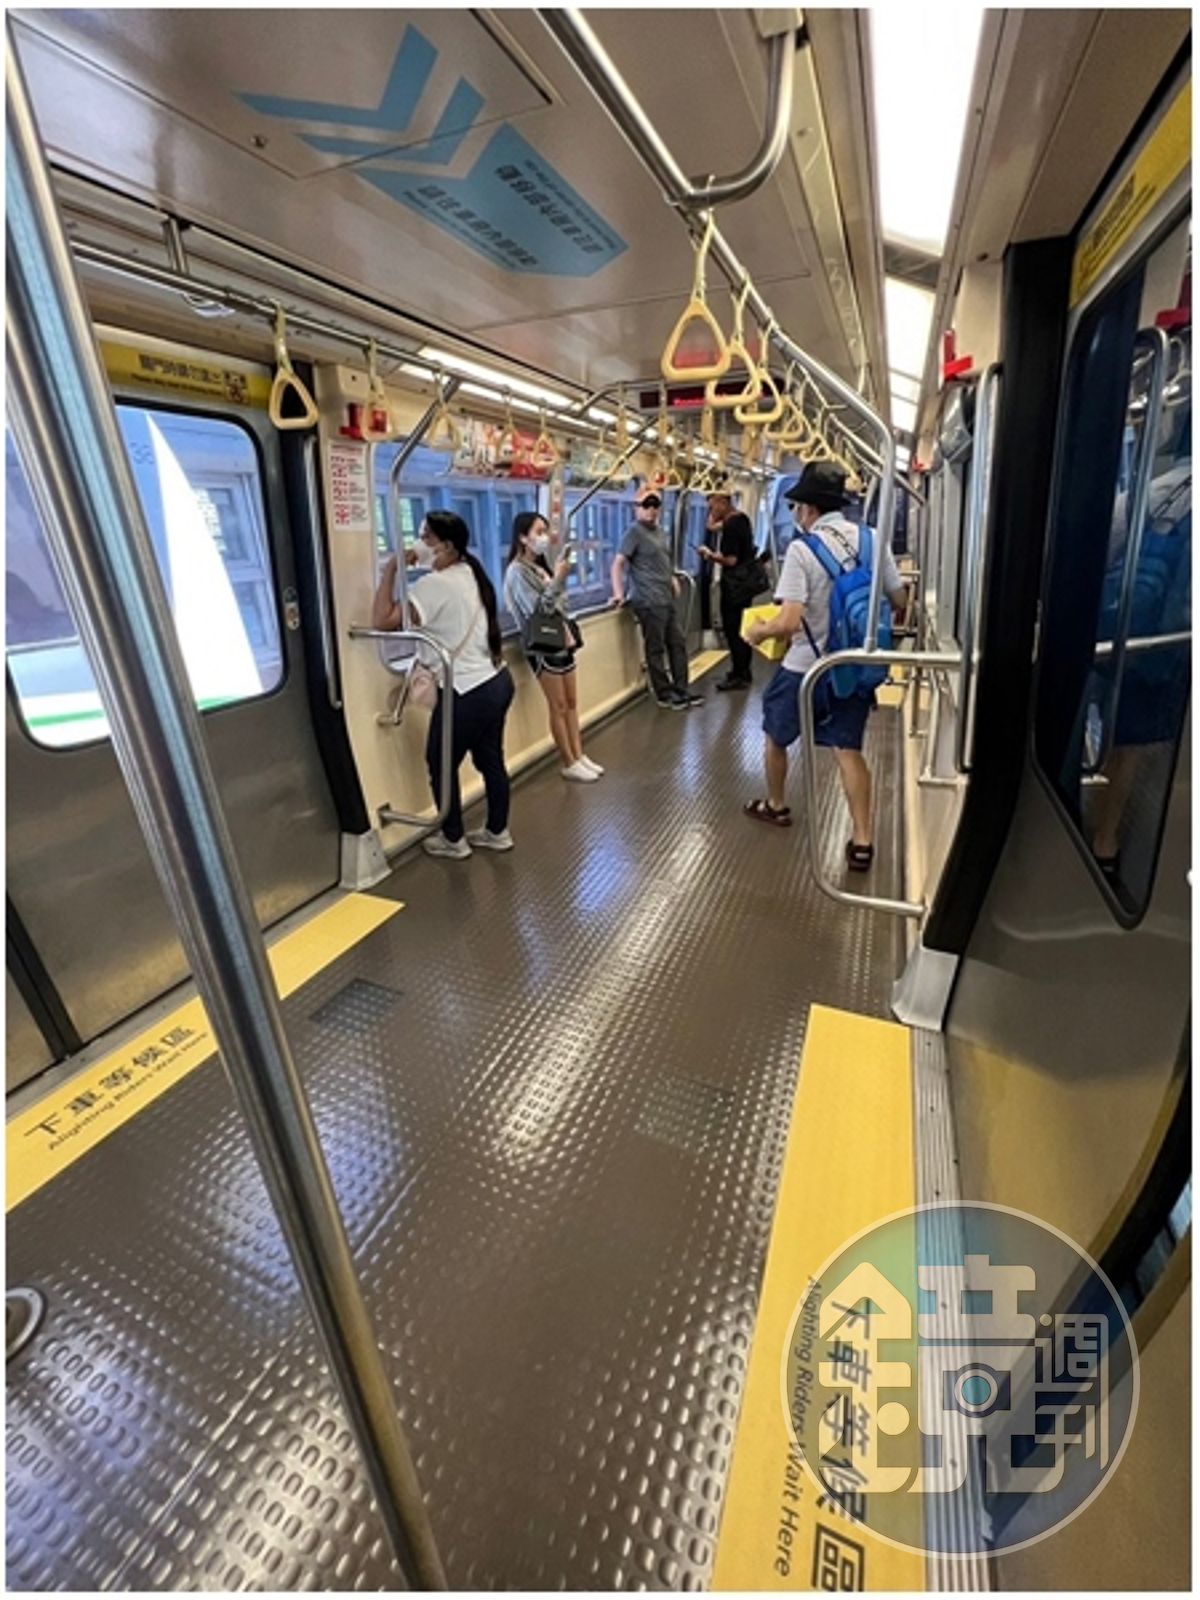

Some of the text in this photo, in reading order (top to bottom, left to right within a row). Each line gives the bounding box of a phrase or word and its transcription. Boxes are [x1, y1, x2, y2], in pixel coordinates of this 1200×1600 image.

[24, 1026, 194, 1136] 下車等候區
[774, 1275, 824, 1577] Alighting Riders Wait Here
